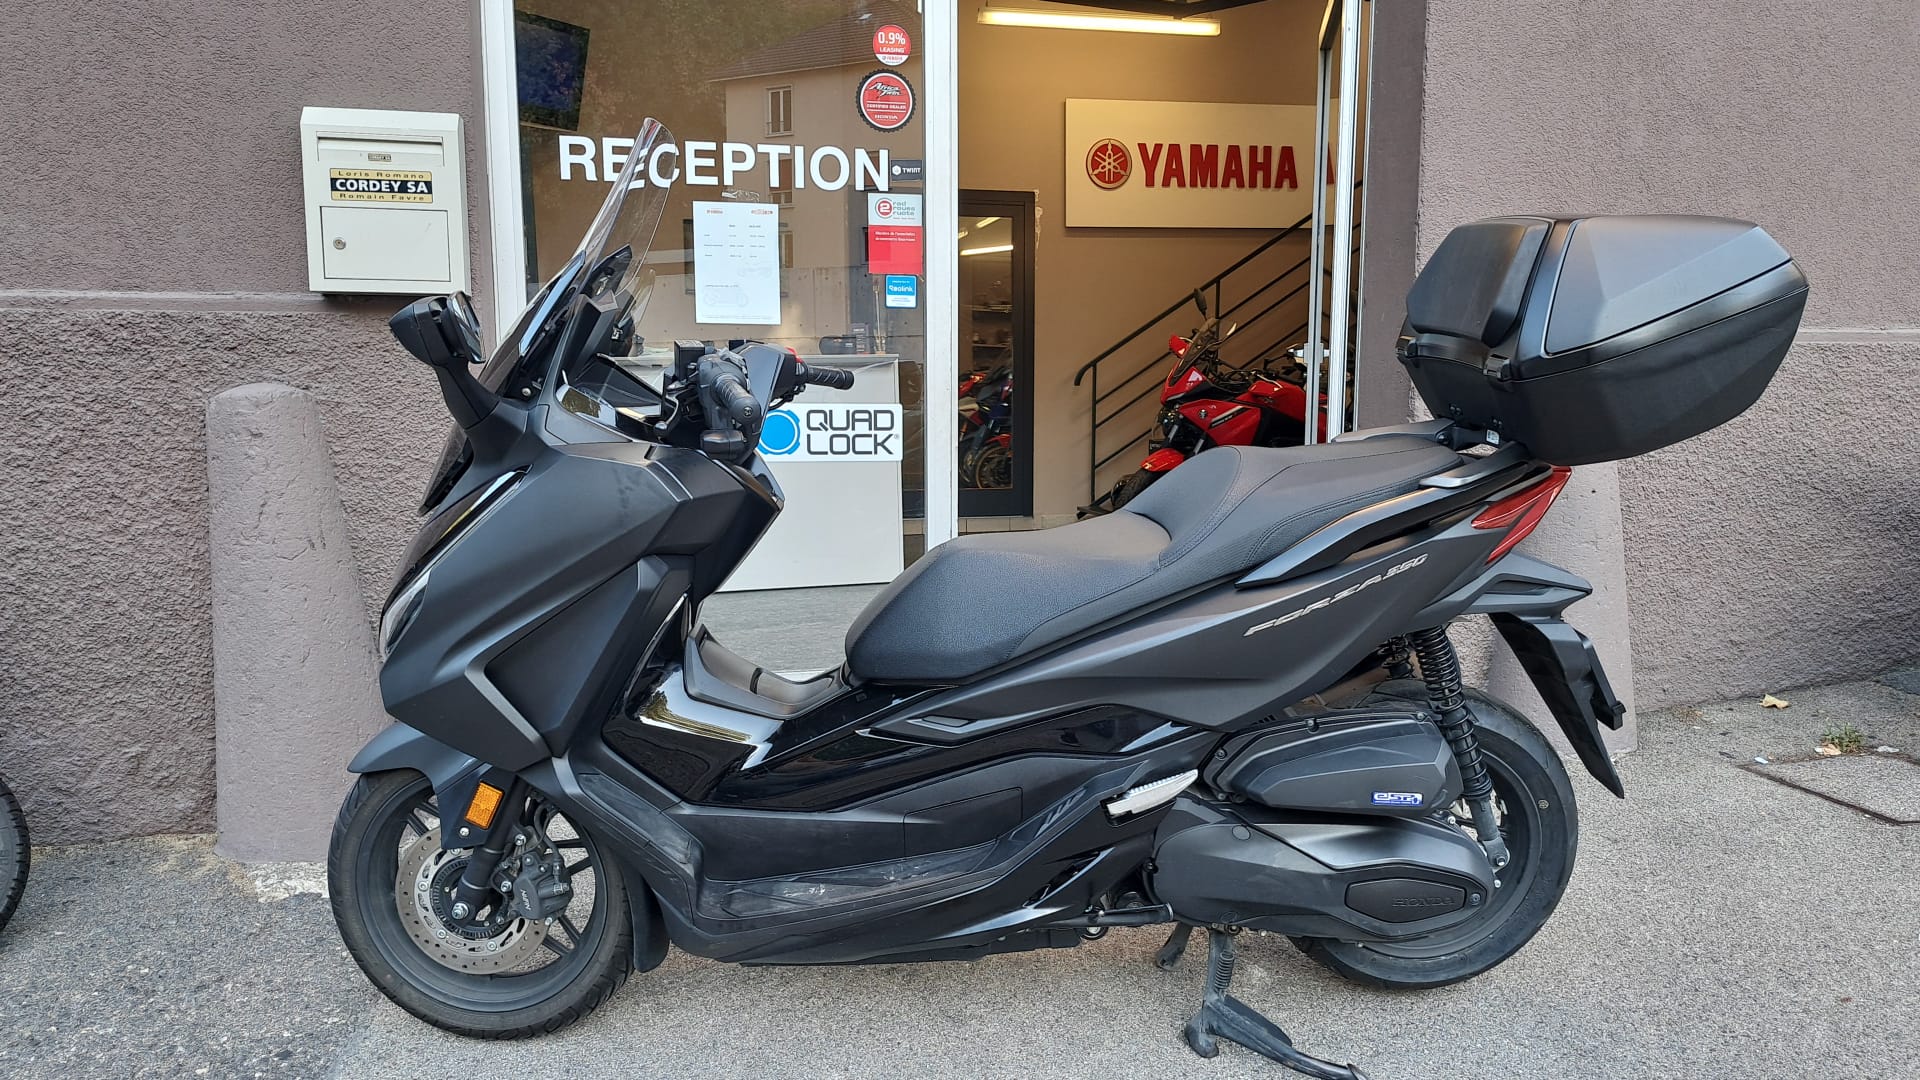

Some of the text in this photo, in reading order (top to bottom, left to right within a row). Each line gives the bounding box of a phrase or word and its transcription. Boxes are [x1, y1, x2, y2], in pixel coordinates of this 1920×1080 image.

[878, 31, 906, 45] 0.9%
[879, 46, 905, 54] LEASING
[557, 134, 890, 192] RECEPTION
[1136, 142, 1299, 189] YAMAHA
[376, 171, 425, 179] Romano
[901, 167, 922, 175] TWINT
[335, 178, 429, 193] CORDEY SA
[339, 192, 385, 200] Romain
[806, 409, 895, 432] QUAD
[806, 433, 895, 456] LOCK
[1243, 574, 1383, 637] FORZA
[1390, 896, 1456, 908] HONDA
